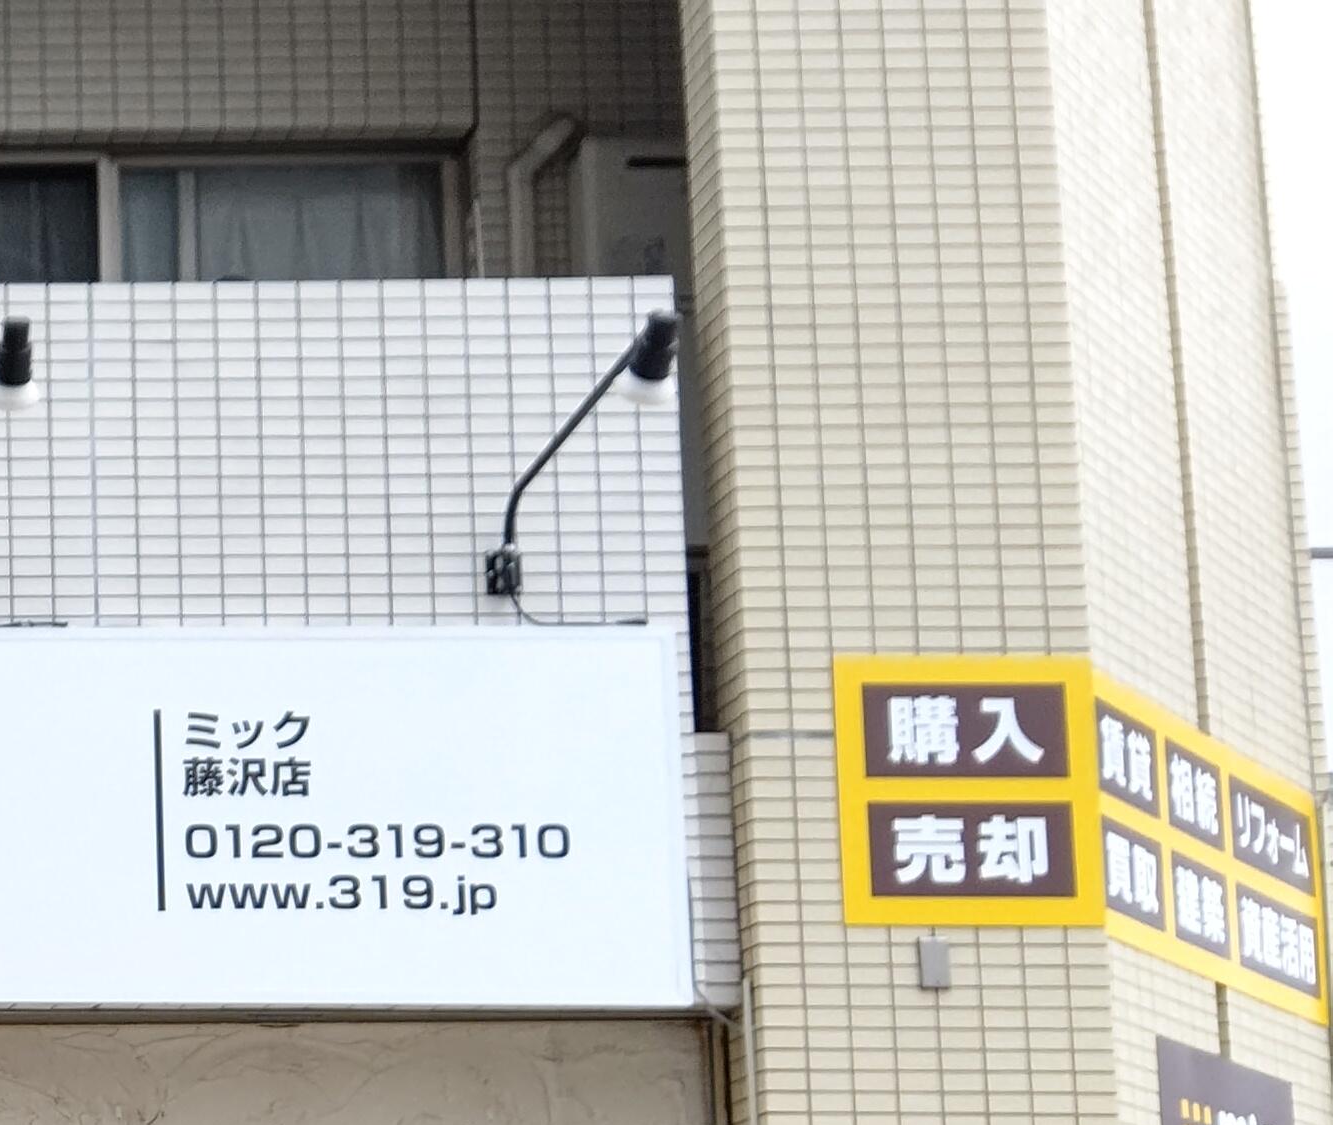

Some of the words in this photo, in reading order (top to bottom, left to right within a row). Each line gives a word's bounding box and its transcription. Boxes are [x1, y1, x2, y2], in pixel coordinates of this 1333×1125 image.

[184, 711, 312, 749] ミック
[886, 694, 1046, 766] 購入
[1098, 714, 1155, 801] 賃貸
[182, 756, 312, 797] 藤沢店
[1168, 752, 1221, 838] 相続
[184, 823, 571, 859] 0120-319-310
[891, 815, 1050, 886] 売却
[1234, 791, 1311, 880] リフォーム
[185, 873, 499, 916] www.319.jp
[1105, 830, 1161, 916] 買取
[1174, 866, 1228, 945] 建築
